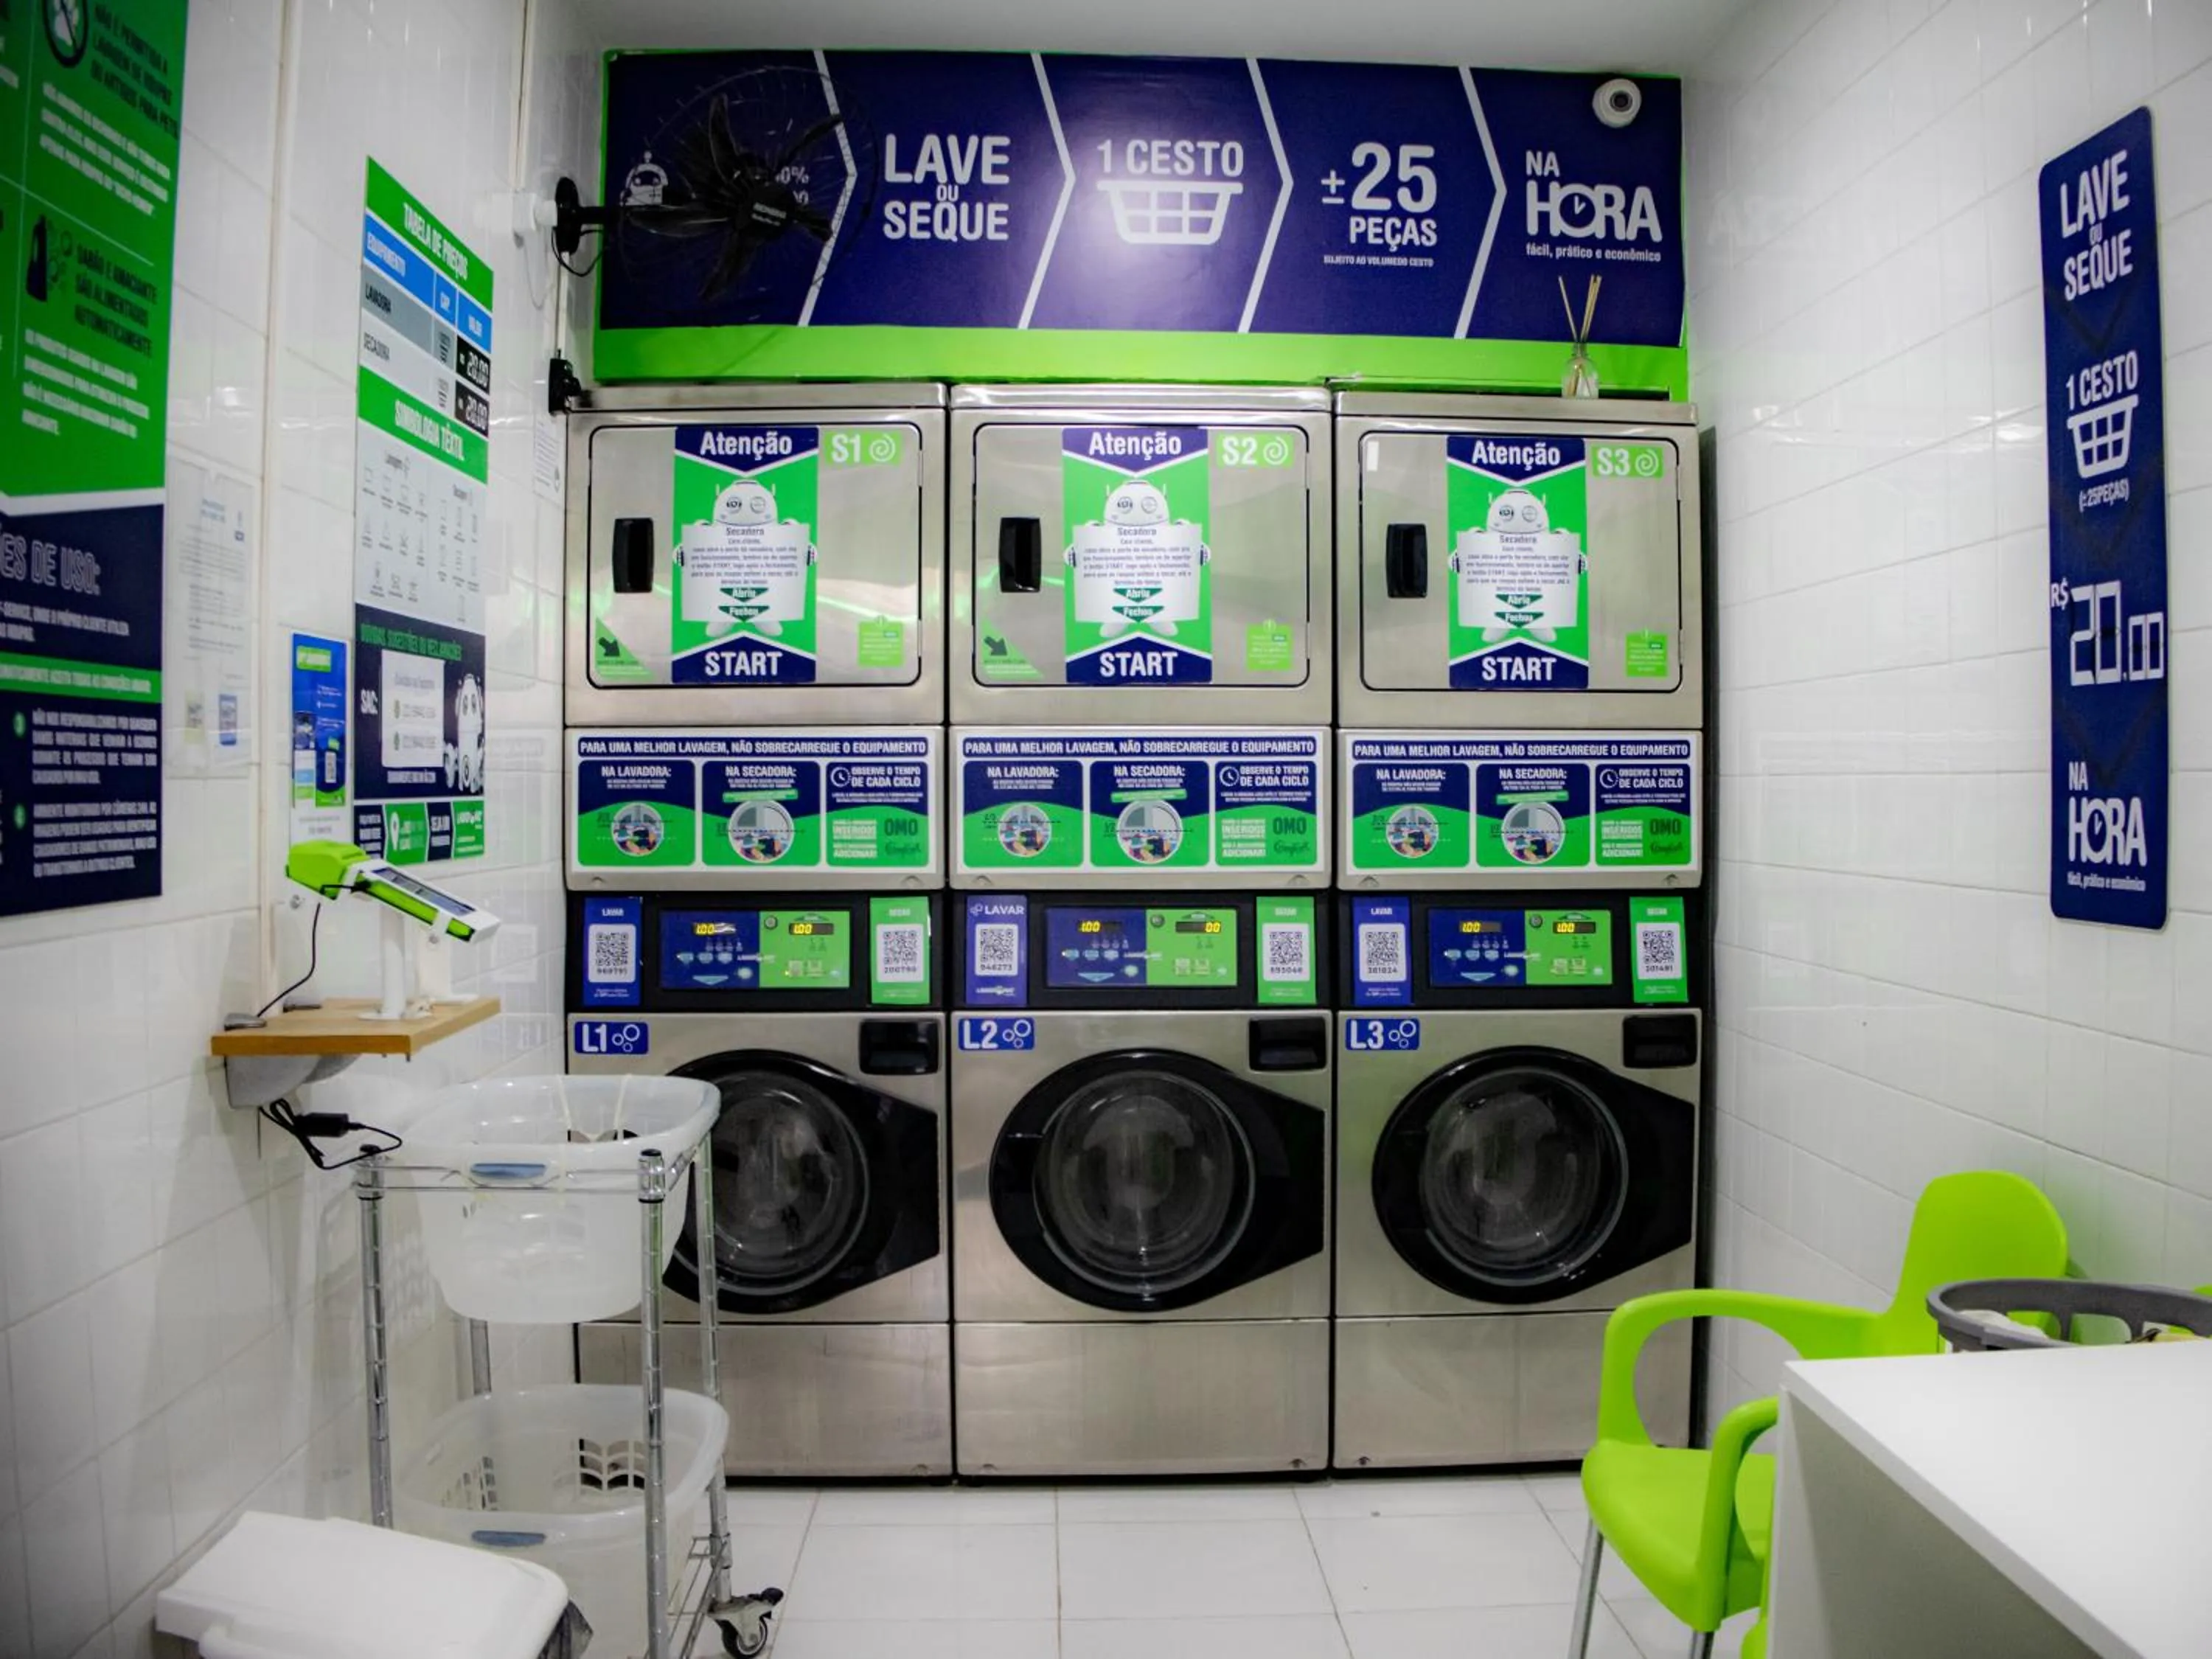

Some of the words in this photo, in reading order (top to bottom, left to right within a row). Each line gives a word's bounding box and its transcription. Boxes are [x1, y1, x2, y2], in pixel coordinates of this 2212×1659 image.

[885, 133, 1011, 185] LAVE
[1096, 139, 1113, 173] 1
[1127, 139, 1244, 177] CESTO
[1526, 150, 1560, 178] NA
[936, 184, 959, 203] OU
[2061, 150, 2130, 239] LAVE
[883, 201, 1009, 242] SEQUE
[1526, 180, 1663, 243] HORA
[1349, 215, 1438, 251] PEÇAS
[2090, 223, 2103, 246] OU
[1526, 242, 1554, 258] fácil,
[1555, 244, 1593, 260] prático
[1595, 248, 1602, 259] e
[1604, 248, 1661, 262] econômico
[2065, 229, 2133, 302] SEQUE
[2065, 374, 2076, 411] 1
[2079, 350, 2138, 406] CESTO
[700, 431, 793, 461] Atenção
[832, 434, 861, 463] S1
[1089, 431, 1182, 461] Atenção
[1222, 436, 1258, 465] S2
[1472, 440, 1561, 471] Atenção
[1597, 448, 1630, 476] S3
[0, 532, 27, 581] ES
[31, 540, 57, 587] DE
[2051, 577, 2068, 611] R$
[705, 651, 783, 676] START
[1099, 652, 1178, 677] START
[1481, 657, 1557, 681] START
[580, 742, 608, 754] PARA
[609, 742, 632, 754] UMA
[633, 742, 676, 754] MELHOR
[678, 742, 729, 755] LAVAGEM,
[731, 740, 753, 754] NÃO
[755, 742, 841, 754] SOBRECARREGUE
[843, 742, 850, 754] O
[852, 742, 926, 754] EQUIPAMENTO
[965, 742, 992, 754] PARA
[995, 742, 1018, 754] UMA
[1020, 742, 1063, 754] MELHOR
[1065, 742, 1117, 755] LAVAGEM,
[1119, 740, 1141, 754] NÃO
[1144, 742, 1229, 754] SOBRECARREGUE
[1231, 742, 1239, 754] O
[1242, 742, 1315, 754] EQUIPAMENTO
[1354, 744, 1382, 756] PARA
[1383, 744, 1407, 756] UMA
[1408, 744, 1450, 756] MELHOR
[1453, 744, 1503, 757] LAVAGEM,
[1504, 742, 1525, 756] NÃO
[1527, 744, 1609, 756] SOBRECARREGUE
[1611, 744, 1618, 756] O
[1620, 744, 1688, 756] EQUIPAMENTO
[601, 765, 616, 777] NA
[725, 765, 740, 777] NA
[851, 776, 864, 787] DE
[866, 776, 891, 787] CADA
[894, 776, 921, 787] CICLO
[987, 766, 1003, 778] NA
[1113, 766, 1129, 777] NA
[1240, 776, 1253, 787] DE
[1255, 776, 1281, 787] CADA
[1282, 776, 1309, 787] CICLO
[1376, 768, 1391, 780] NA
[1499, 768, 1514, 779] NA
[1618, 779, 1631, 788] DE
[1633, 779, 1656, 788] CADA
[1658, 779, 1683, 788] CICLO
[2069, 761, 2088, 791] NA
[884, 818, 918, 836] OMO
[1273, 818, 1307, 835] OMO
[1649, 818, 1681, 835] OMO
[2069, 796, 2147, 867] HORA
[984, 905, 1024, 915] LAVAR
[582, 1023, 607, 1053] L1
[964, 1020, 998, 1049] L2
[1350, 1020, 1384, 1049] L3
